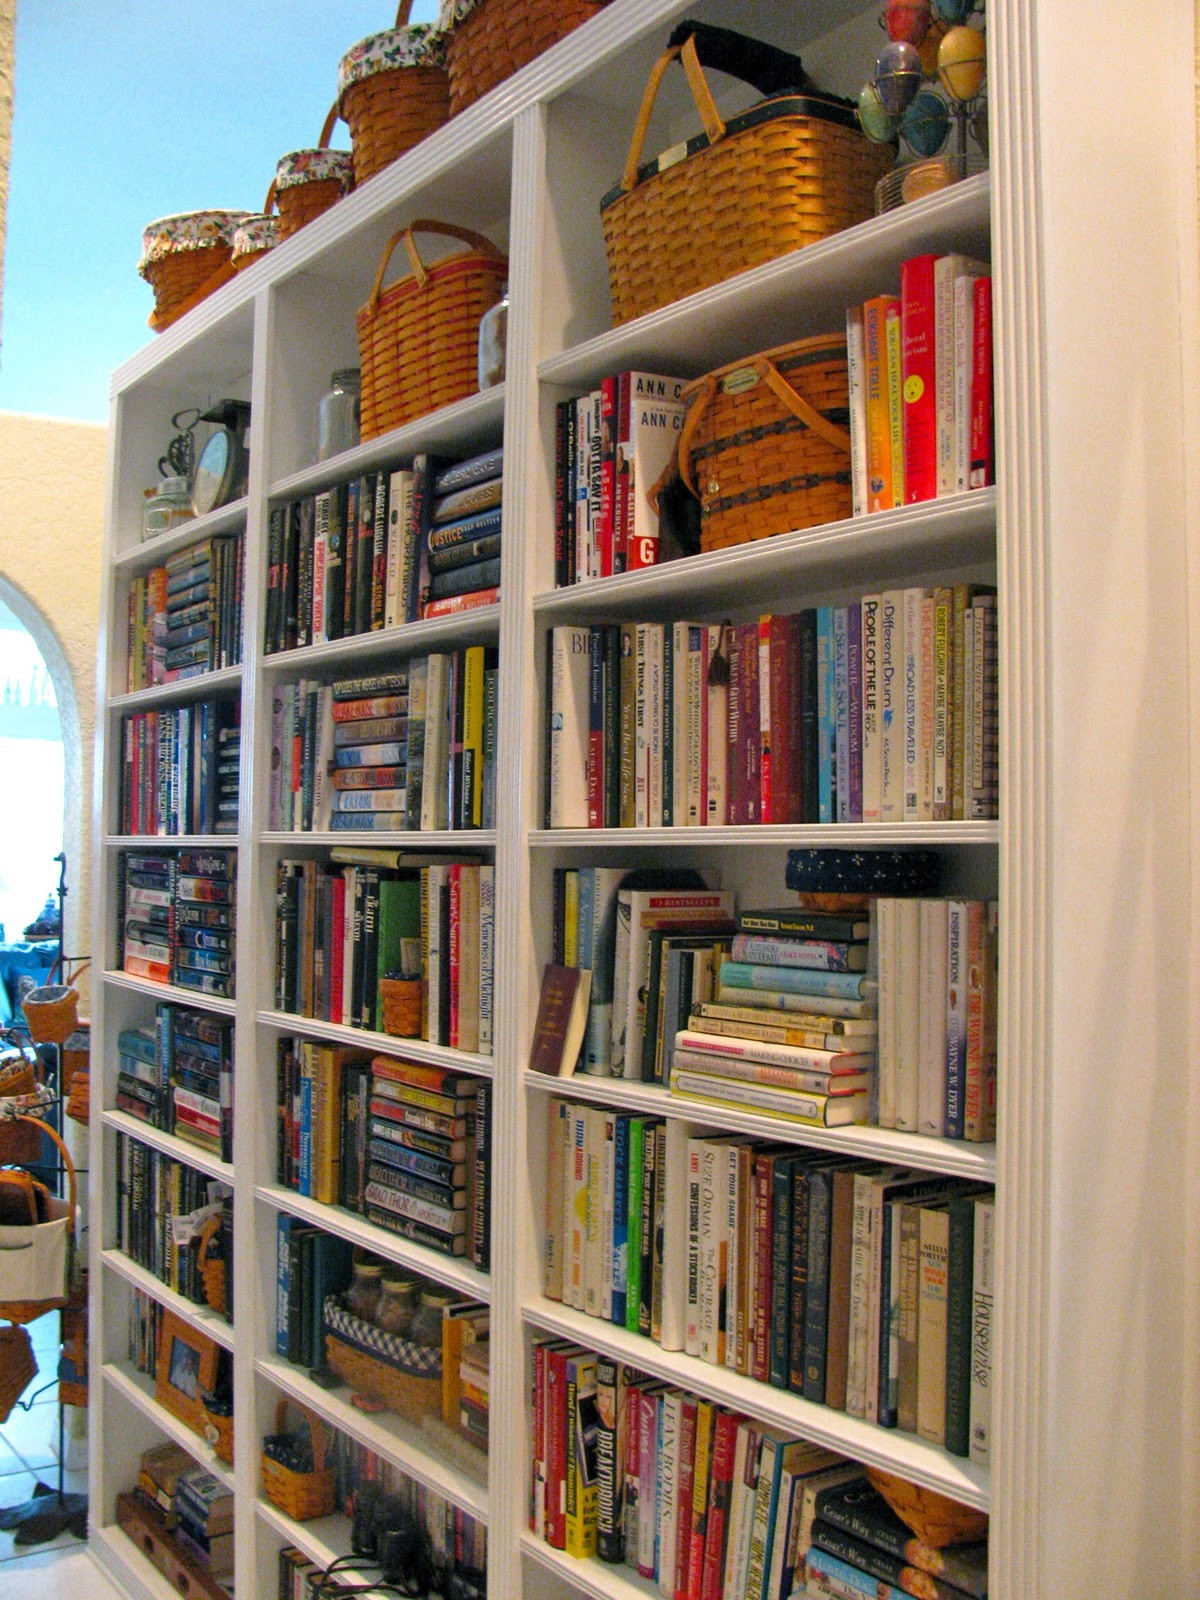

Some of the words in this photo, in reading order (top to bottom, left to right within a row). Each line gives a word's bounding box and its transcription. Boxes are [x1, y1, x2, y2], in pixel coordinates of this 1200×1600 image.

[864, 601, 879, 648] PEOPLE
[883, 606, 895, 667] Different
[935, 608, 946, 637] ROBERT
[884, 667, 894, 707] Drum
[950, 911, 959, 984] INSPIRATION
[948, 1036, 958, 1073] WAYNE
[948, 1090, 957, 1119] DYER
[973, 1291, 994, 1388] Housewise
[597, 1429, 613, 1534] BREAKTHROUGH
